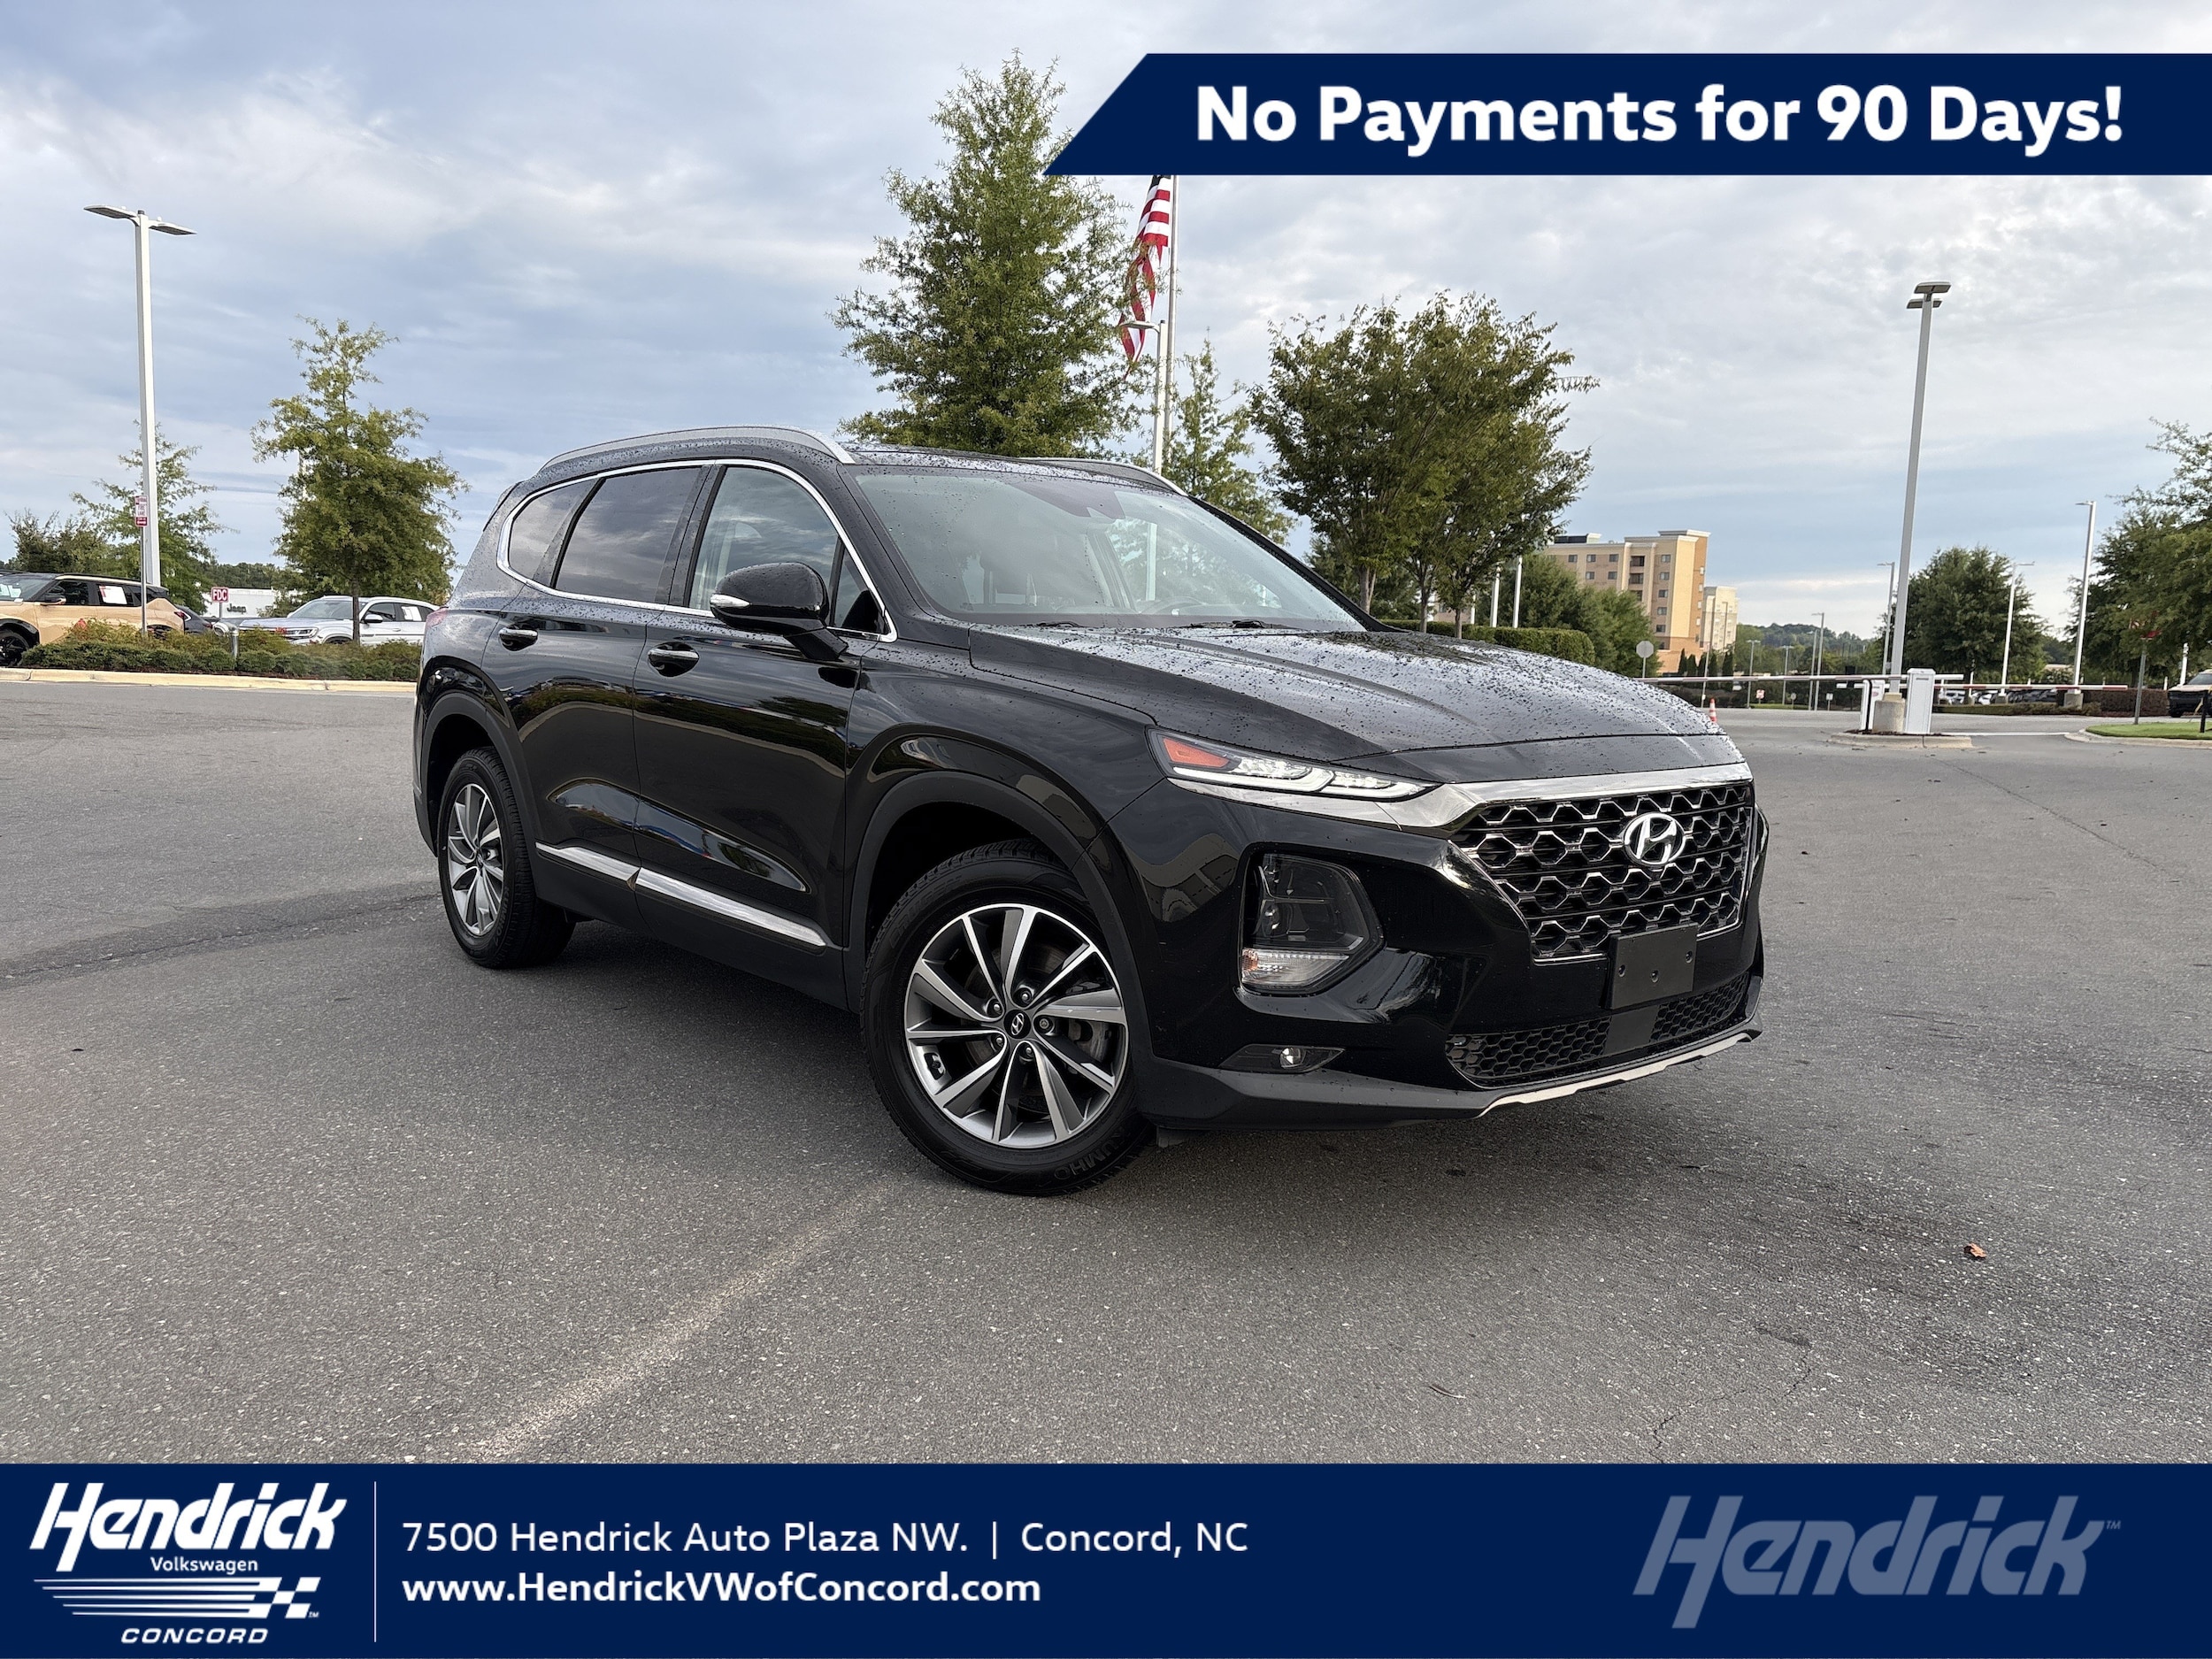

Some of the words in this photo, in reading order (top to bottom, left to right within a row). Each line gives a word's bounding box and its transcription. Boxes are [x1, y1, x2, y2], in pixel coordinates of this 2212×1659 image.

[212, 588, 227, 601] FDC
[227, 603, 247, 615] Jeep
[1054, 1125, 1125, 1180] KUMHO
